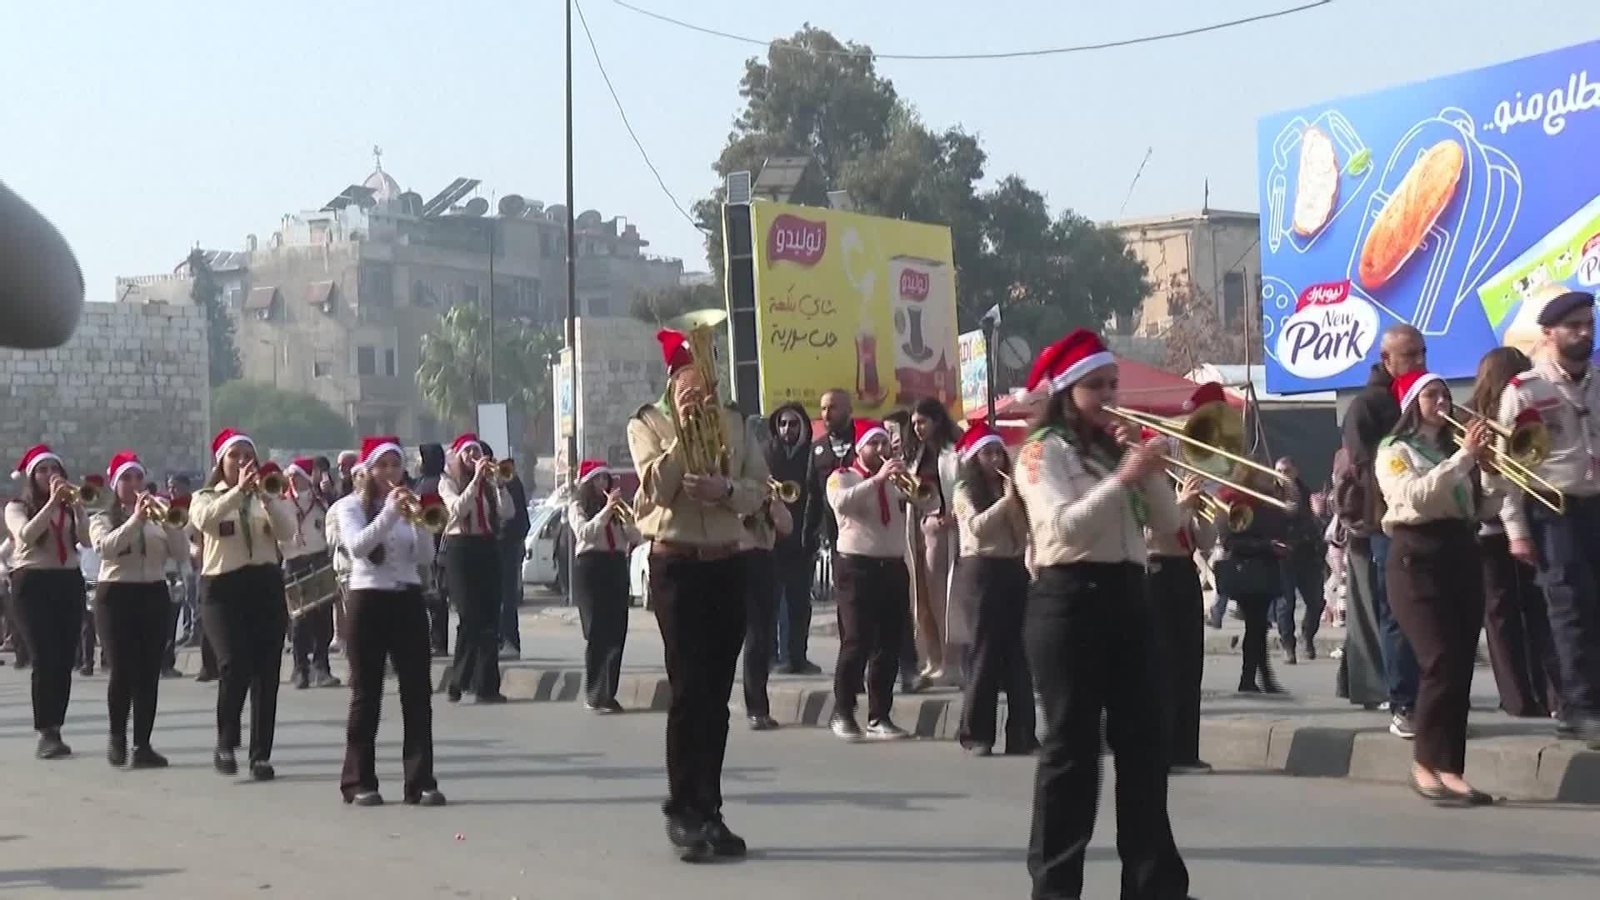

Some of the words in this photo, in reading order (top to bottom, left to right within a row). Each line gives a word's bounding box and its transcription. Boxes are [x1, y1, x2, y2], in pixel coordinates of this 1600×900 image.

[1543, 69, 1600, 136] طلع
[775, 226, 822, 257] توليدو
[799, 293, 839, 320] شاي
[1321, 310, 1354, 328] New
[770, 323, 808, 354] سورية
[1285, 320, 1366, 366] Park
